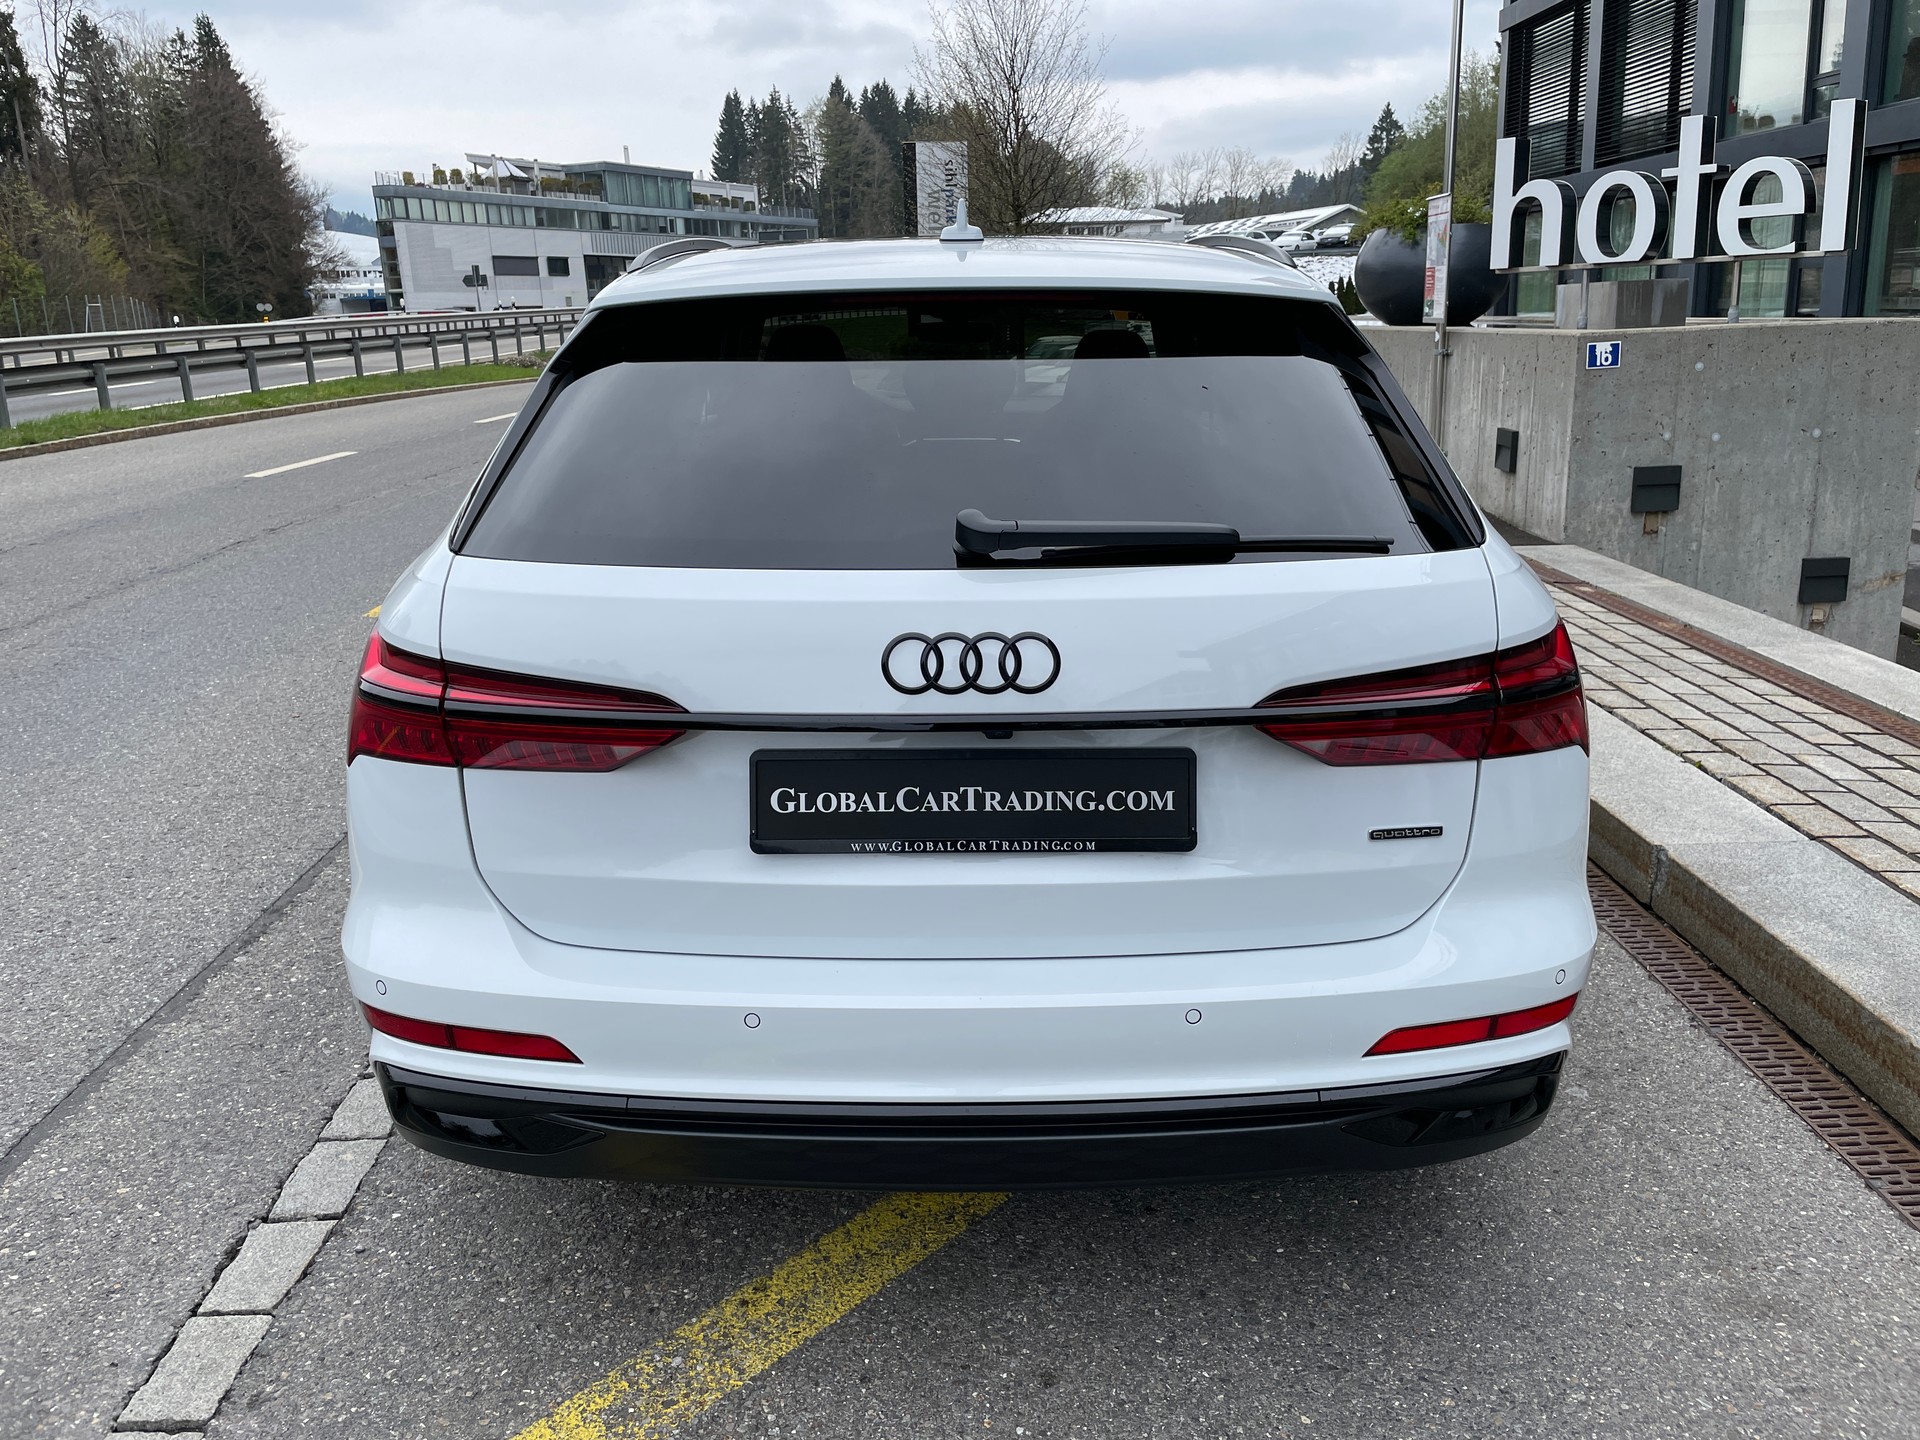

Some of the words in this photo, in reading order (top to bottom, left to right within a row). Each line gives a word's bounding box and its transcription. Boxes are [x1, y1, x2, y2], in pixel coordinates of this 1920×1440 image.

[941, 159, 957, 224] sihlpark
[1490, 98, 1857, 270] hotel
[1373, 828, 1441, 839] quattro
